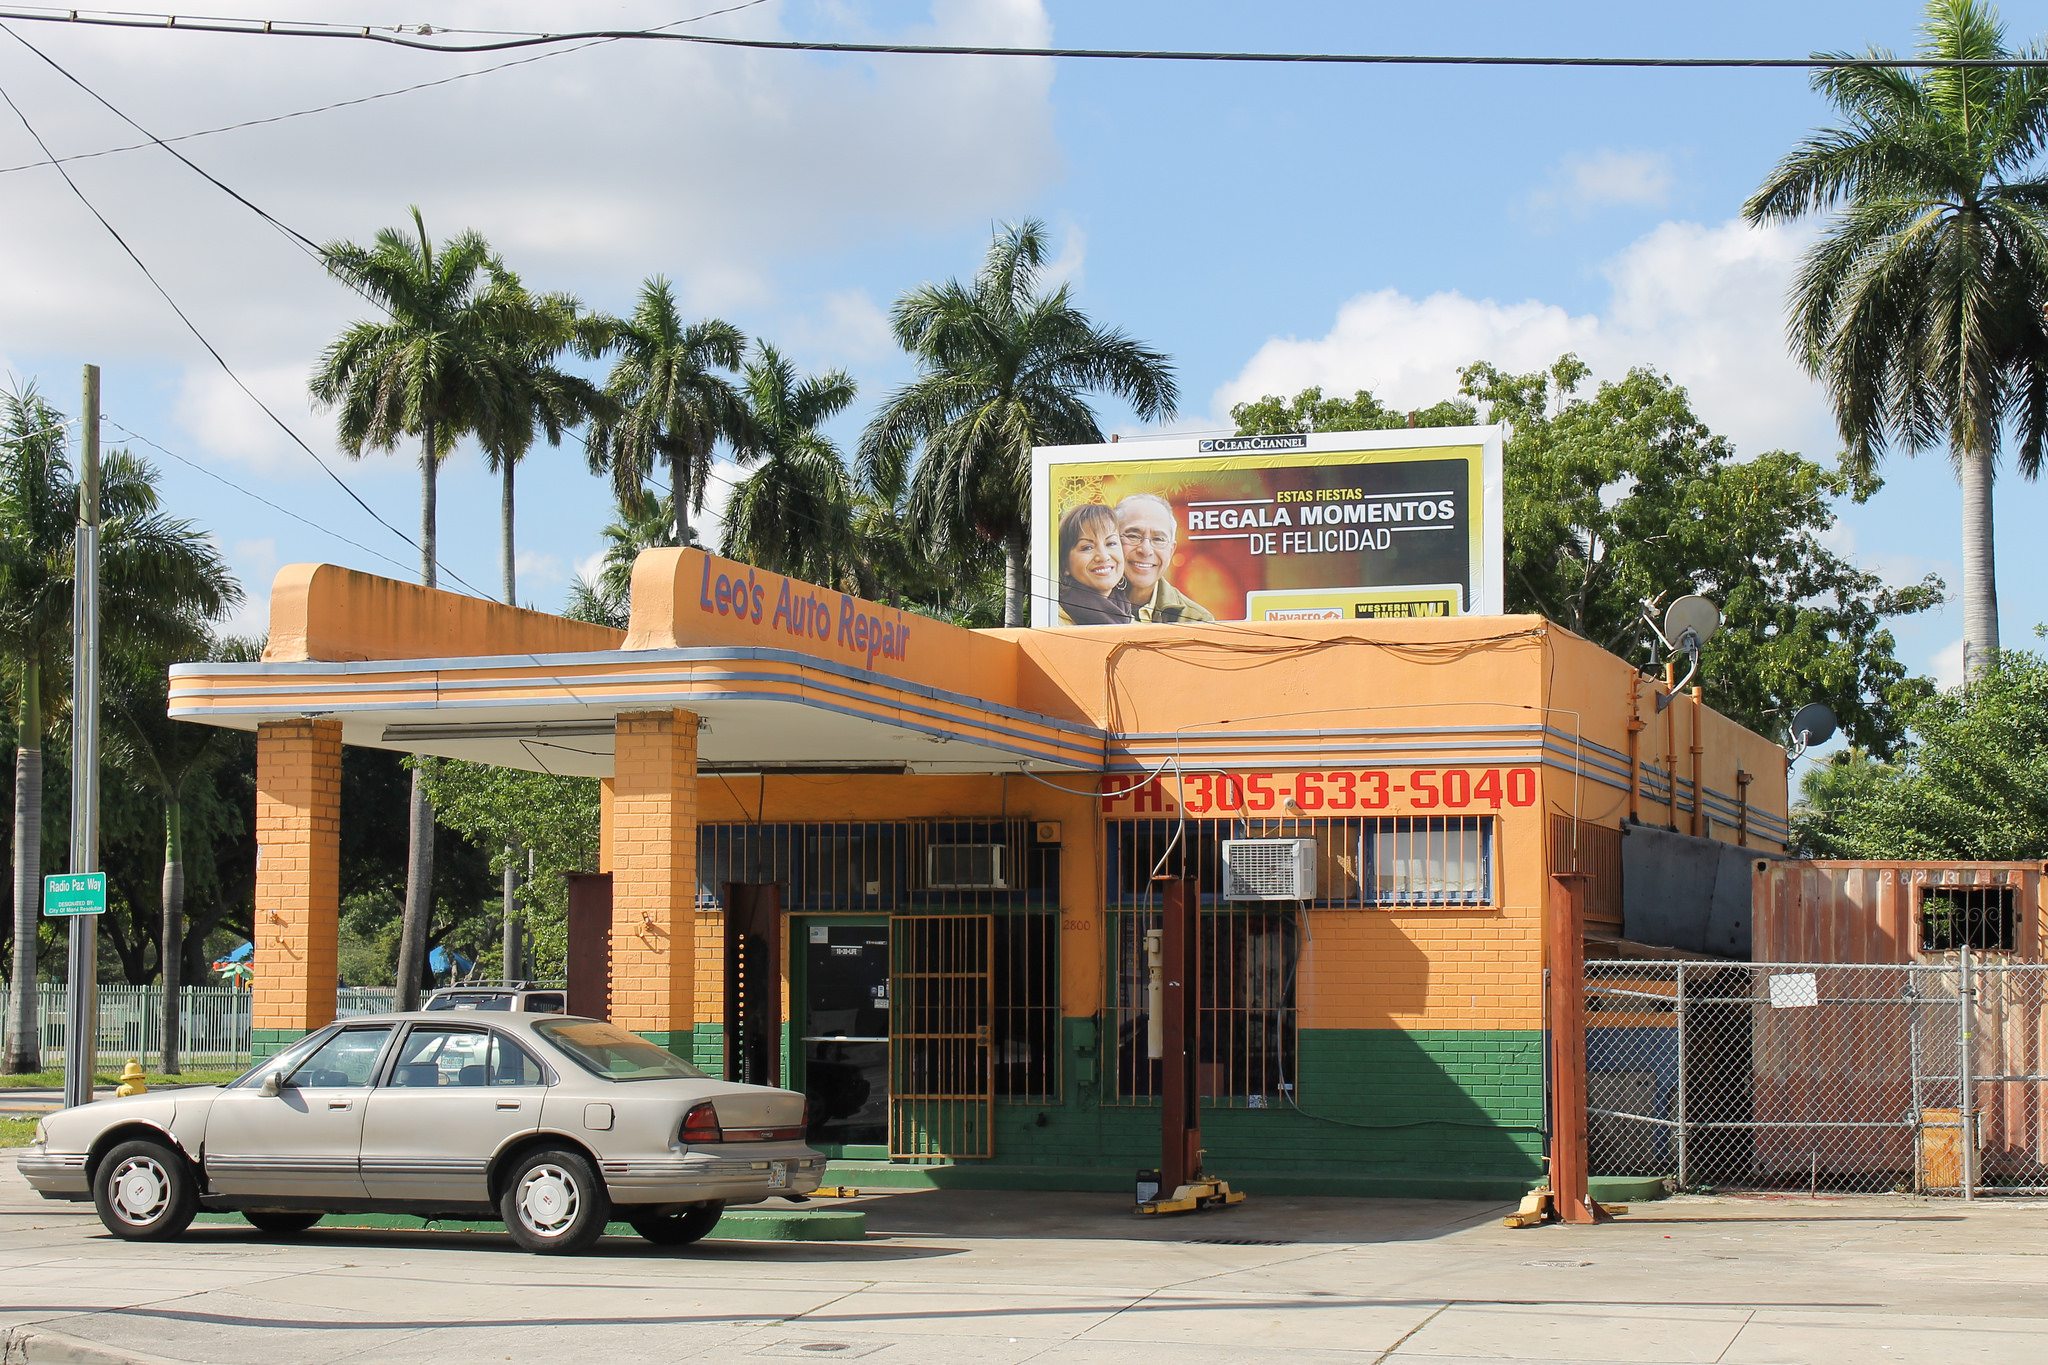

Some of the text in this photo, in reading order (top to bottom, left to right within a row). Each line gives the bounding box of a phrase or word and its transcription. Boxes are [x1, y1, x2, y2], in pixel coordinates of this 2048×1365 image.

[1276, 487, 1363, 503] ESTAS FIESTAS
[1188, 499, 1456, 531] REGALA MOMENTOS
[1249, 527, 1392, 556] DE FELICIDAD
[700, 555, 910, 670] Leo's Auto Repair
[1357, 603, 1409, 613] WESTERN
[1373, 611, 1409, 619] UNION
[1268, 610, 1321, 622] Navarro
[1101, 768, 1536, 813] PH. 305-633-5040
[50, 878, 101, 892] Radio Paz Way
[1063, 919, 1091, 931] 2800
